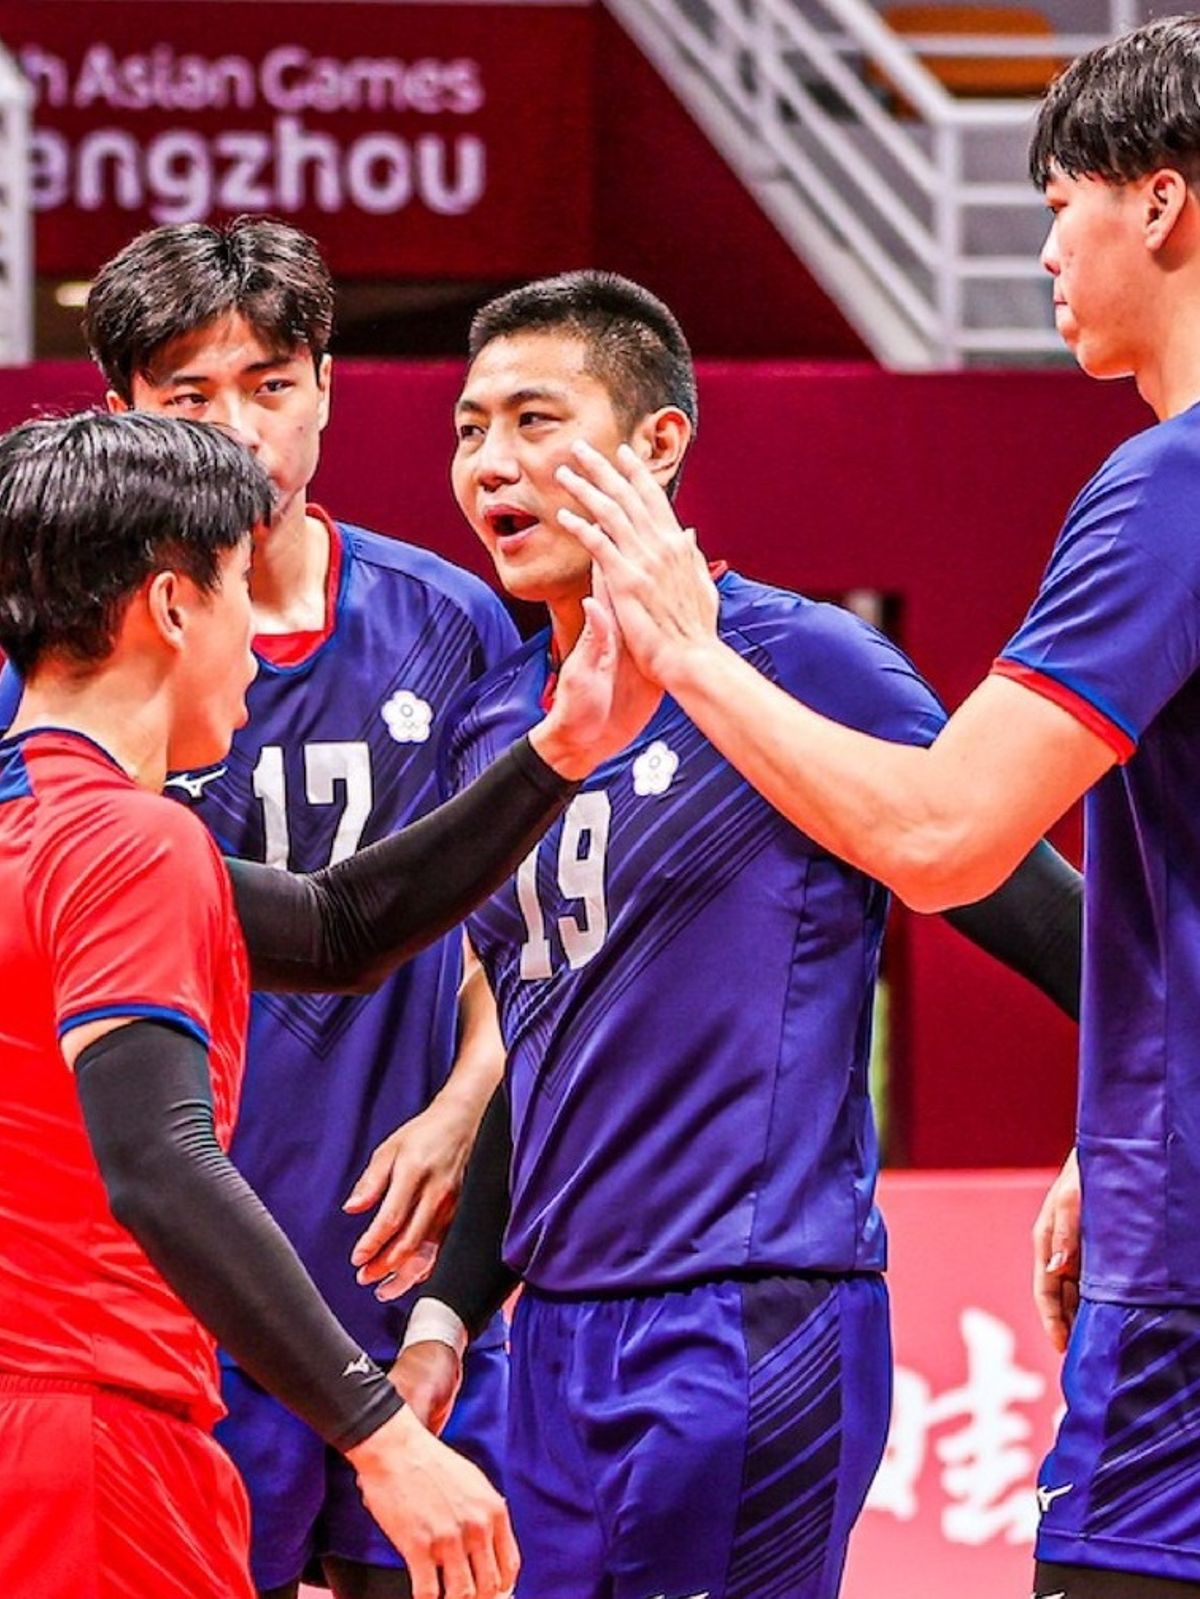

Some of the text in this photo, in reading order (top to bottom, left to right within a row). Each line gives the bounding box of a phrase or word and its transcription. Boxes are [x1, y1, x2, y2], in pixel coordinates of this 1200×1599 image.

[75, 44, 257, 110] Asian
[260, 46, 487, 114] Games
[252, 741, 373, 872] 17
[517, 790, 612, 980] 19
